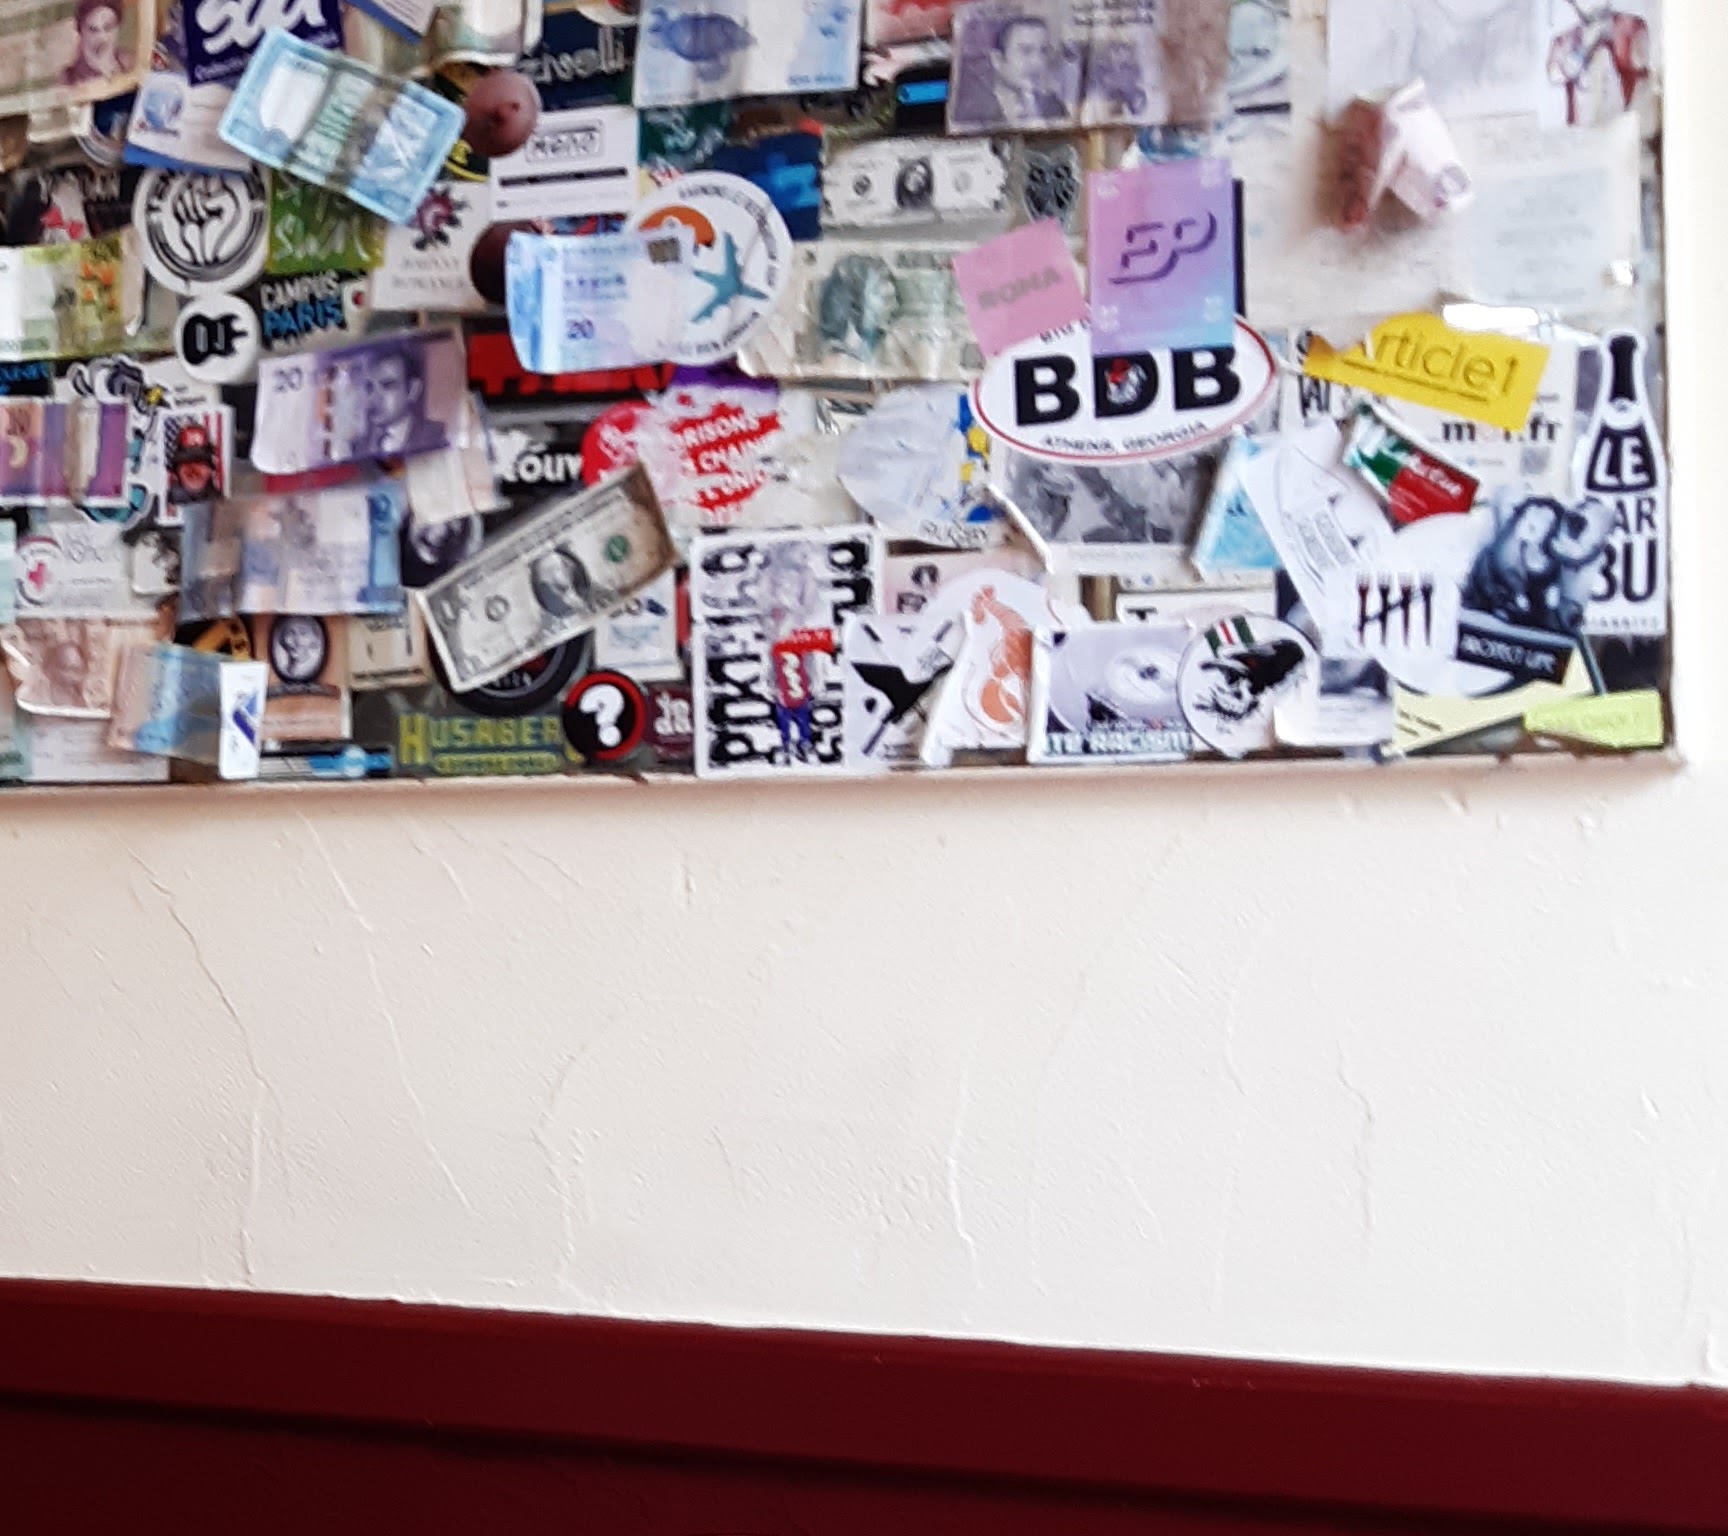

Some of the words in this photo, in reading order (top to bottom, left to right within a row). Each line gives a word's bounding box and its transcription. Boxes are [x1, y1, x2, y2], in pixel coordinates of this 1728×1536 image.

[260, 271, 341, 311] CAMPUS
[261, 300, 346, 342] PARIS
[1014, 346, 1242, 428] BDB
[1599, 432, 1652, 489] LE
[1600, 495, 1658, 535] AR
[398, 712, 566, 764] HUSABER
